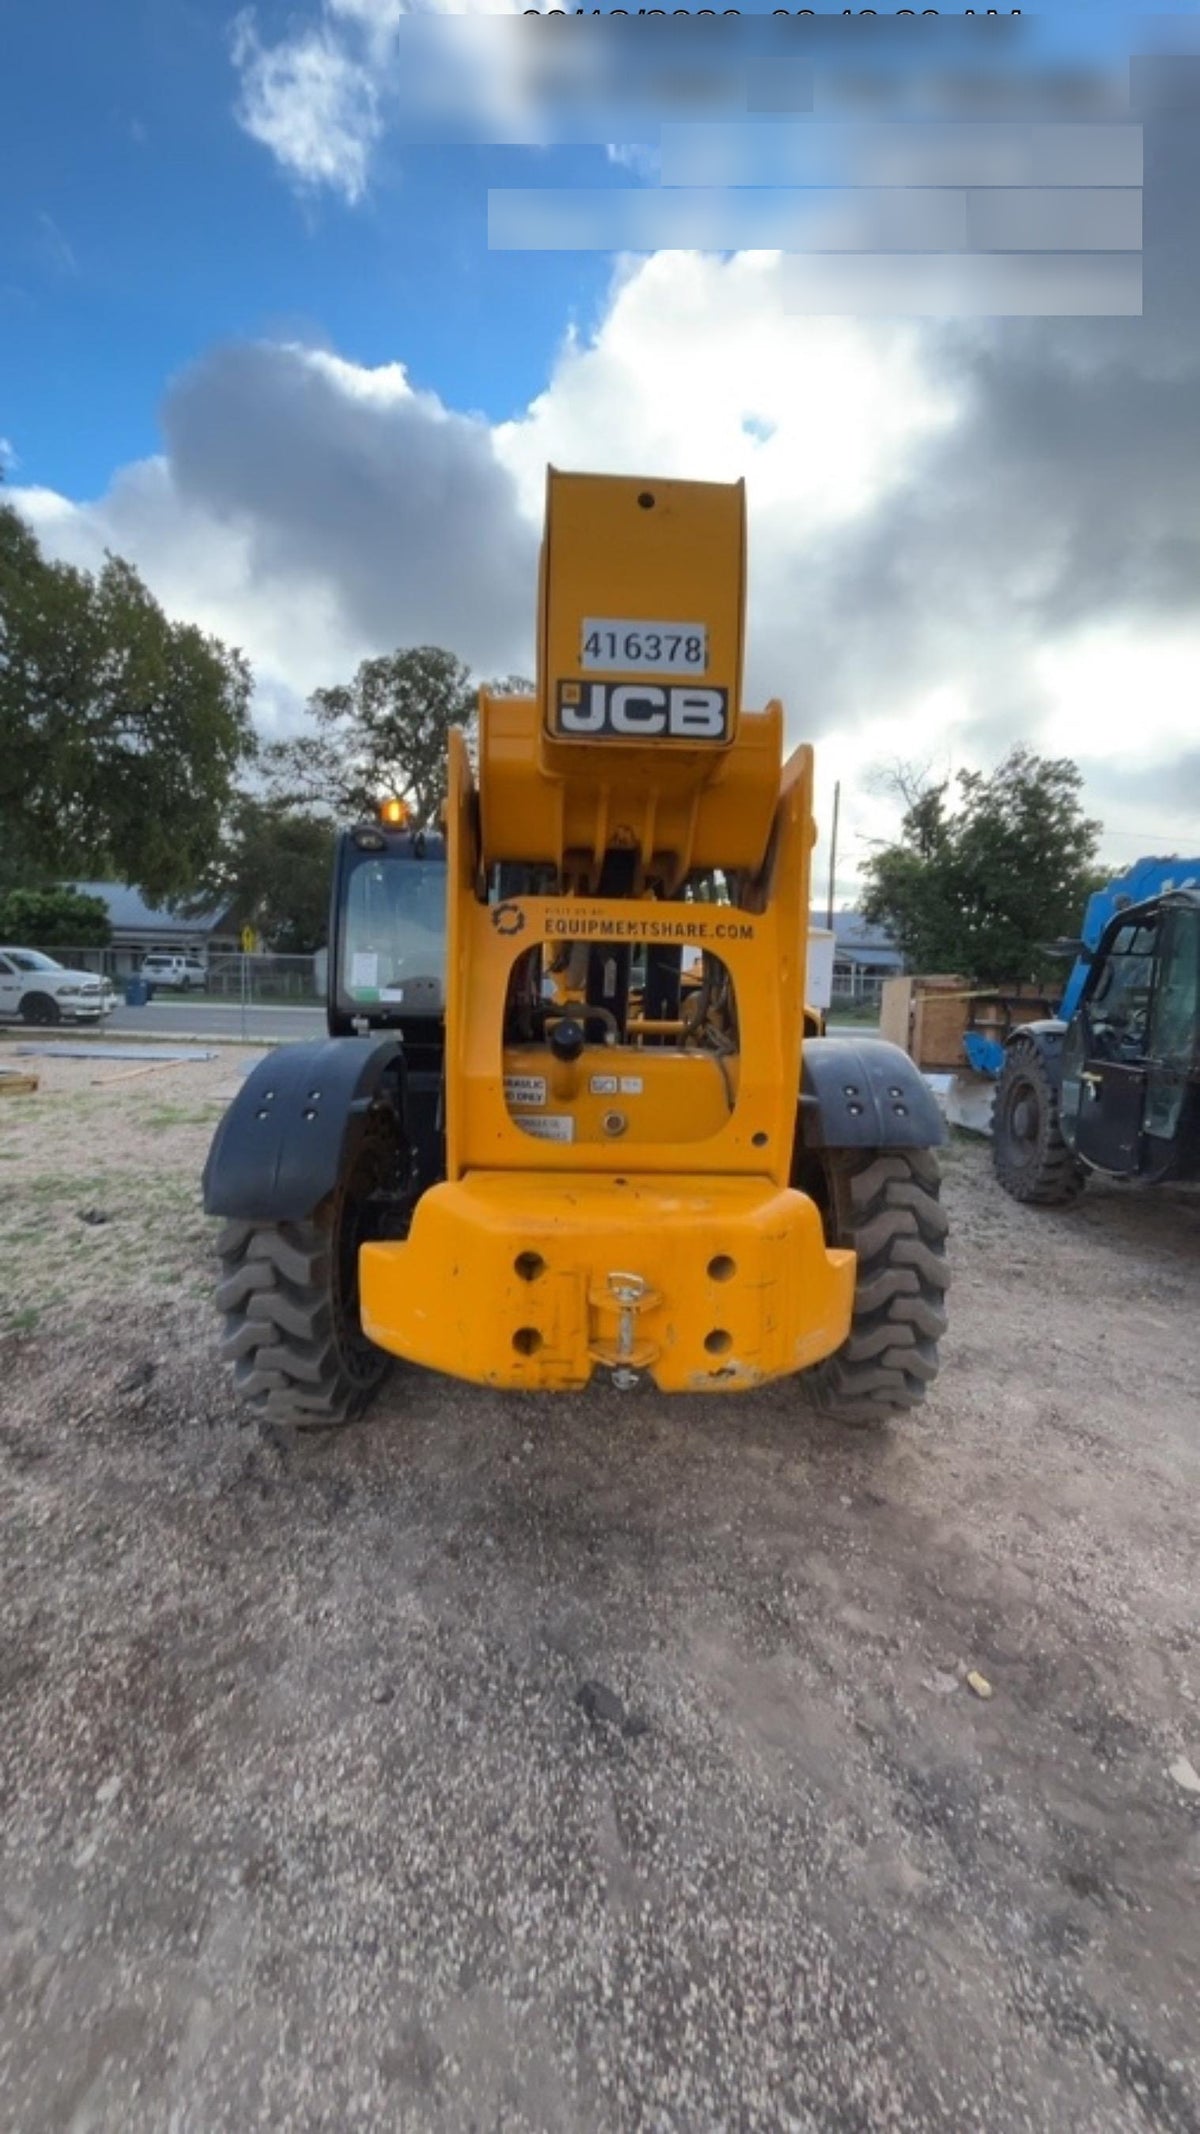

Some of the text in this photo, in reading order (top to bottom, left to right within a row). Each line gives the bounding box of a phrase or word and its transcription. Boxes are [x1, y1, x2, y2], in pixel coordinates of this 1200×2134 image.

[584, 632, 702, 662] 416378
[560, 684, 724, 736] JCB
[545, 919, 754, 939] EQUIPMENTSHARE.COM
